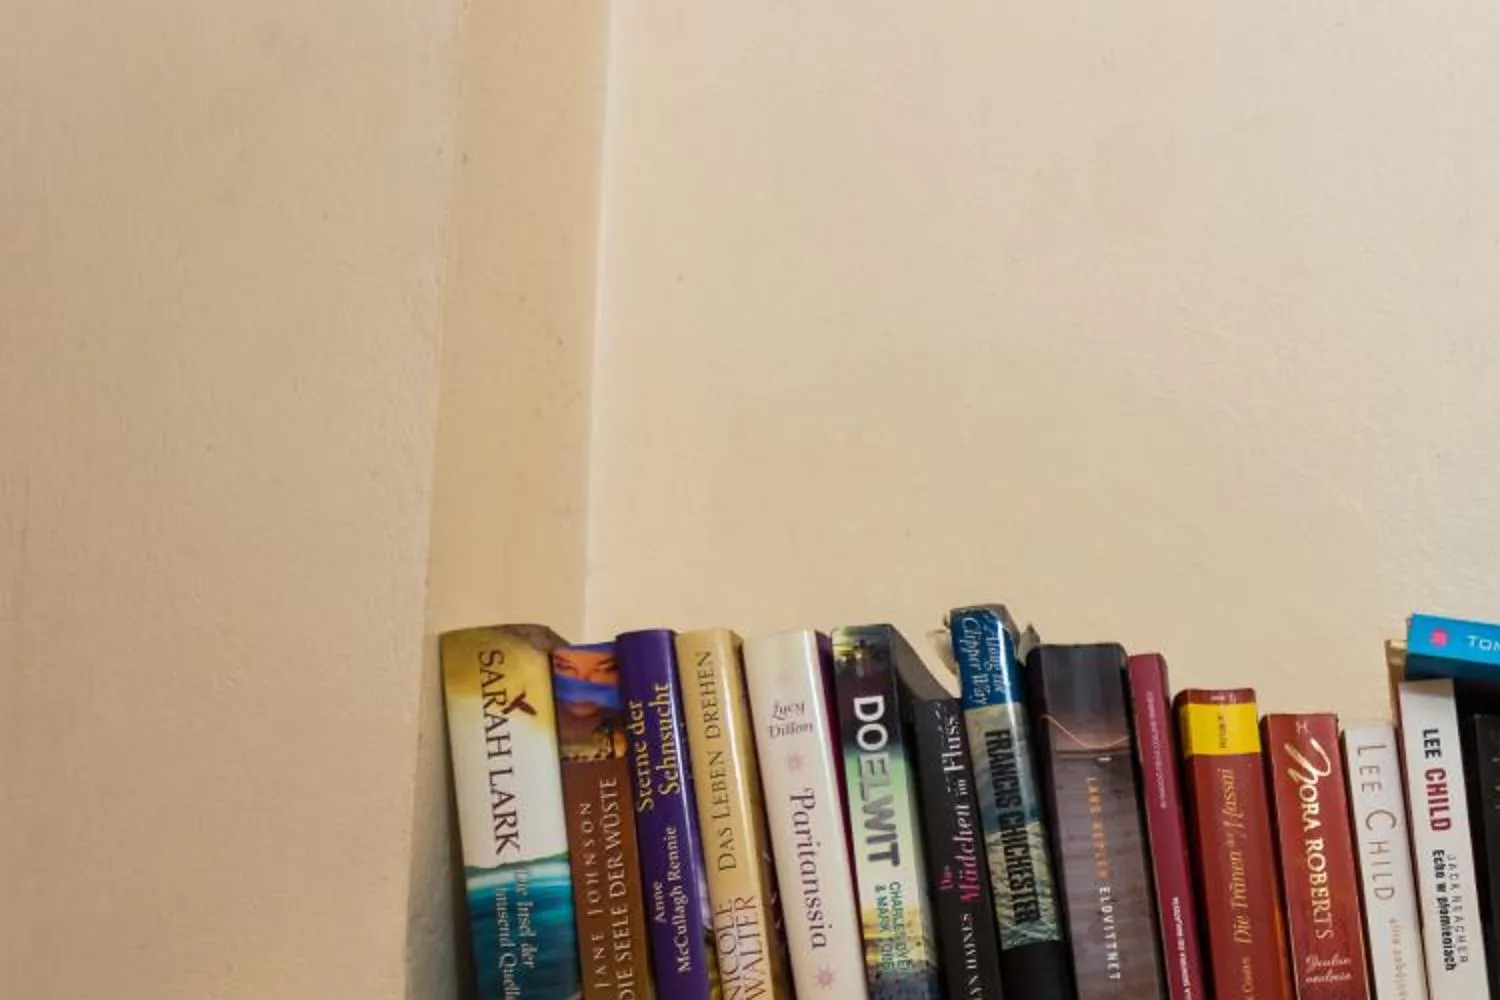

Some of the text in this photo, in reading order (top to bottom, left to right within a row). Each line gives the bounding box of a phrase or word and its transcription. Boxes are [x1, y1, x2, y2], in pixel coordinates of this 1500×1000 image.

[478, 650, 521, 855] SARAH LARK
[626, 700, 653, 813] Sterne der
[649, 683, 680, 796] Sehnsucht
[697, 651, 737, 871] DAS LEBEN DREHEN
[854, 695, 900, 867] DOELWIT
[942, 715, 965, 773] Fluss
[1423, 729, 1451, 831] LEE CHILD
[607, 852, 627, 898] DER
[984, 729, 1041, 925] FRANCIS CHICHESTER
[1285, 737, 1334, 940] NORA ROBERTS
[1358, 744, 1397, 900] LEE CHILD
[1433, 850, 1444, 879] Echo
[517, 901, 536, 938] Insel
[579, 802, 611, 988] JANE JOHNSON
[611, 903, 632, 962] SEELE
[654, 881, 667, 924] Anne
[663, 826, 692, 974] McCullagh Rennie
[1229, 851, 1248, 911] Tränen
[1233, 915, 1252, 943] Die
[1447, 855, 1469, 964] JACK REACHER
[521, 942, 537, 968] der
